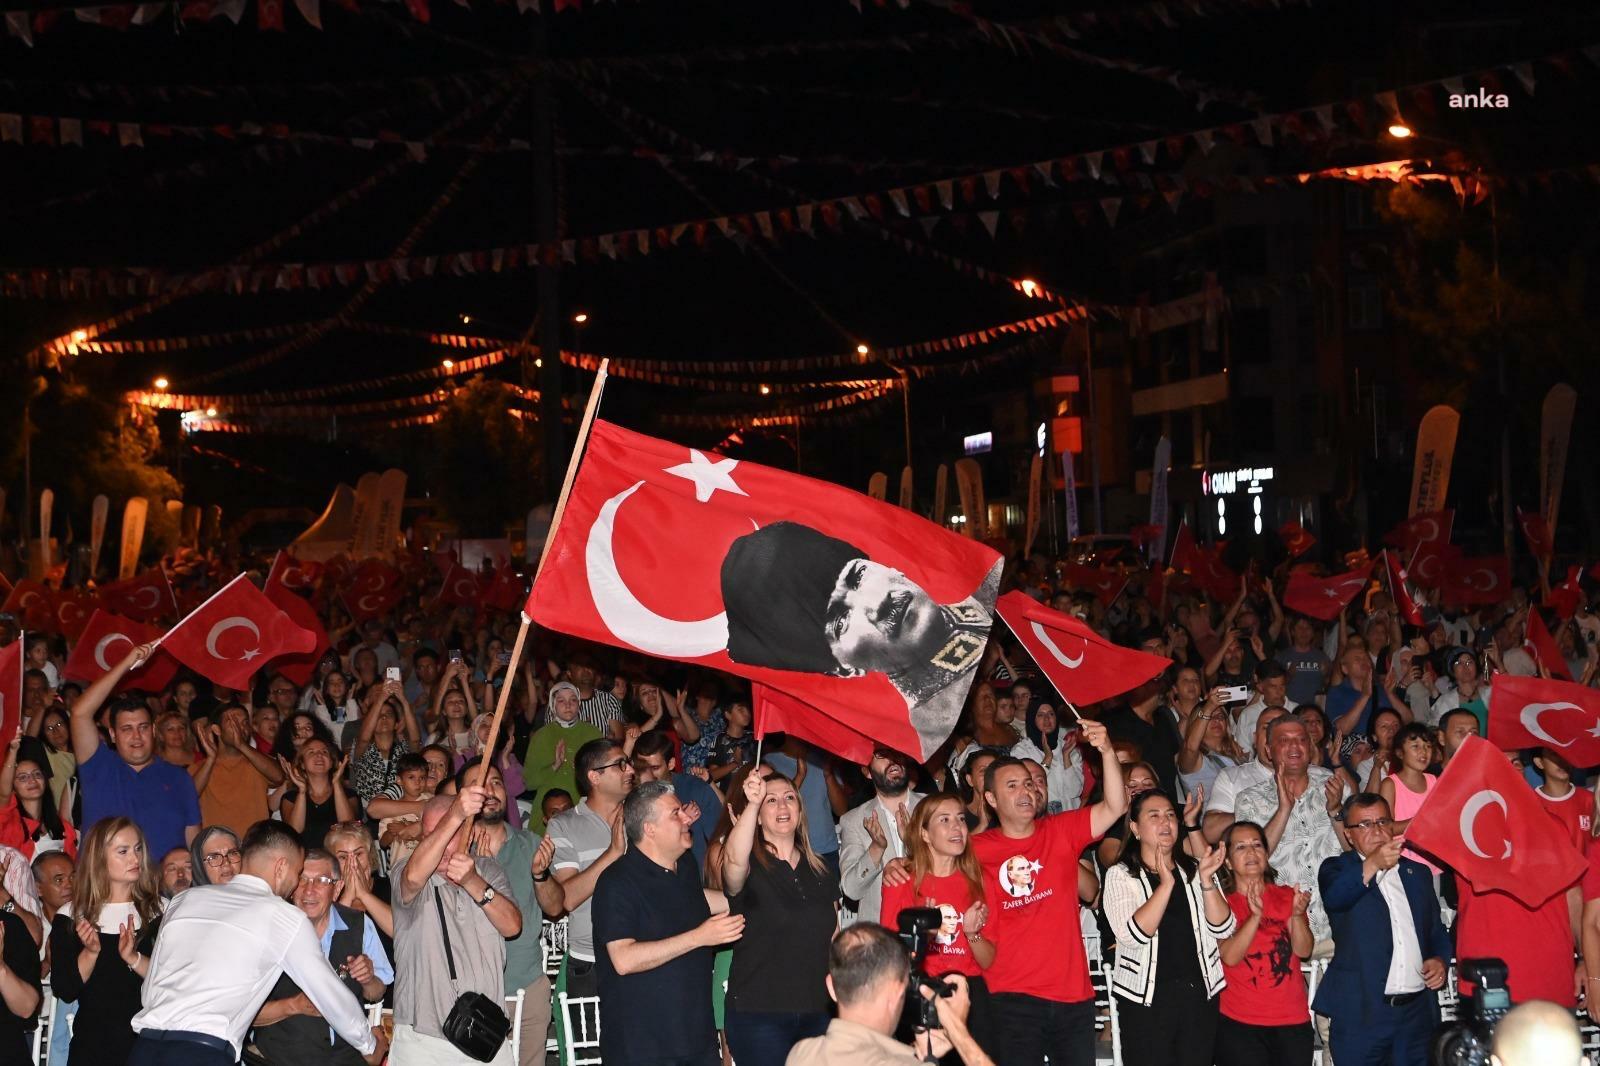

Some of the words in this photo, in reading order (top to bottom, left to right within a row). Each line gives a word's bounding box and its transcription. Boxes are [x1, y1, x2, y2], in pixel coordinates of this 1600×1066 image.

[1002, 899, 1023, 909] ZAFER
[1024, 888, 1053, 904] BAYRAMI
[943, 945, 965, 955] BAYRA
